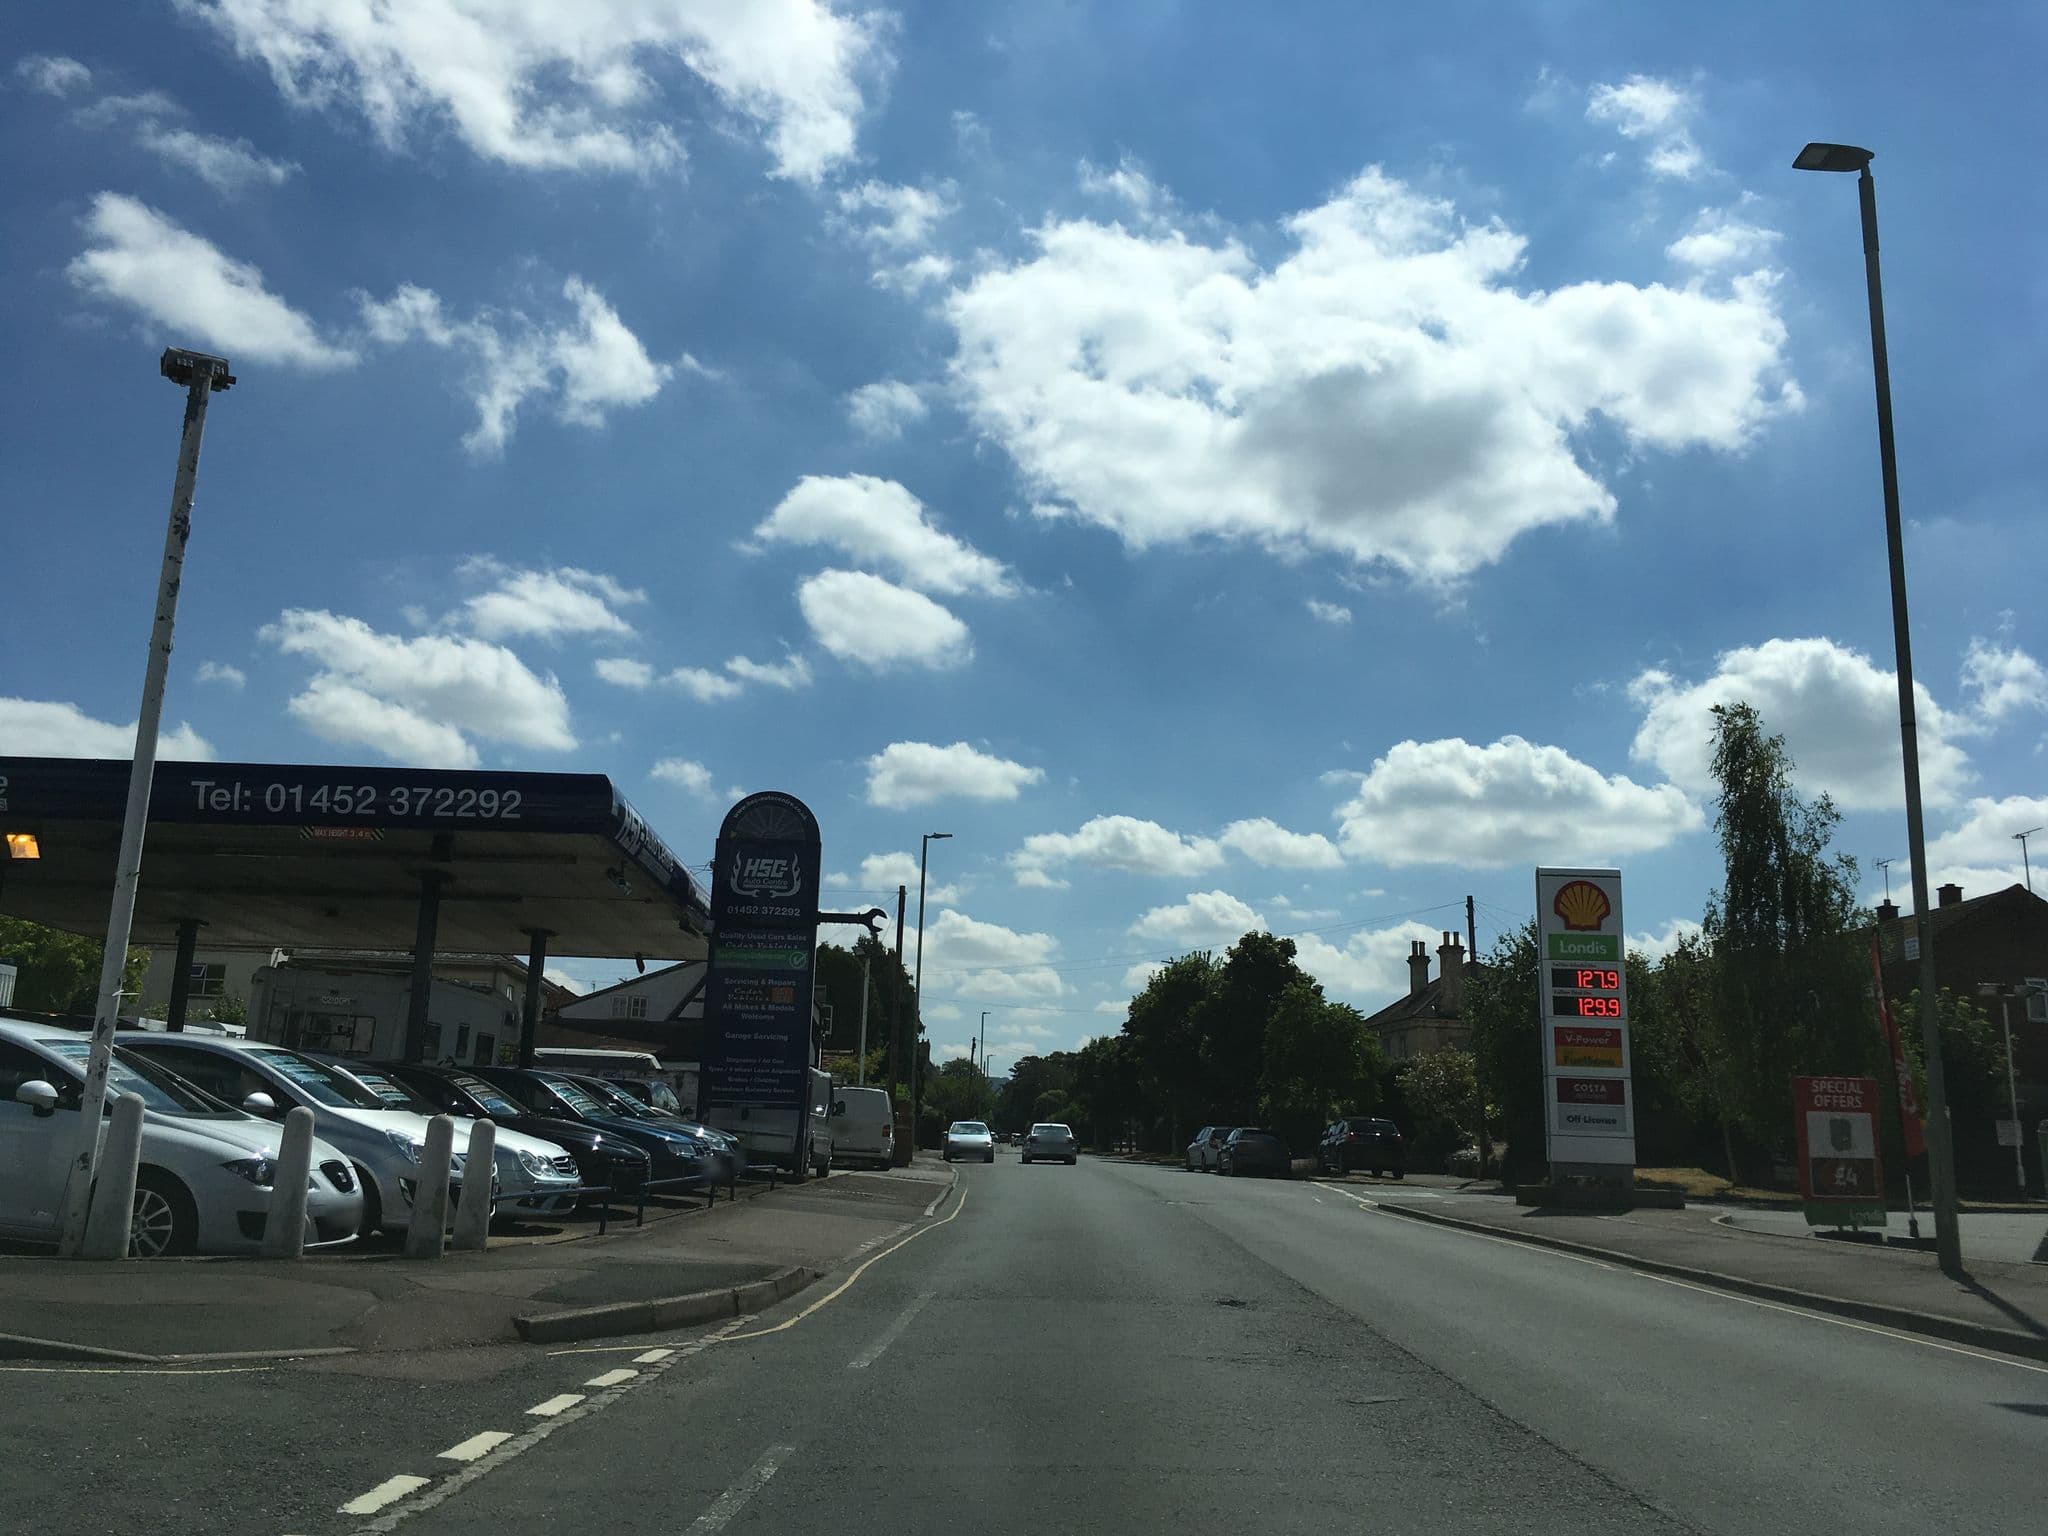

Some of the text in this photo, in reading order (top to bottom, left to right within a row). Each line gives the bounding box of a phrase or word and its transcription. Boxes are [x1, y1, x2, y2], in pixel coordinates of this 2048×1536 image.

[190, 780, 521, 820] Tel: 01452 372292
[328, 829, 349, 837] HEIGHT
[743, 858, 789, 878] HSC
[762, 878, 789, 886] Centre
[727, 905, 801, 917] 01452 372292
[720, 932, 746, 941] Quality
[1560, 940, 1607, 954] Londis
[724, 978, 759, 986] Servicing
[768, 978, 796, 987] Repairs
[1577, 970, 1618, 989] 127.9
[734, 1003, 759, 1011] Makes
[768, 1004, 796, 1012] Models
[1578, 998, 1620, 1017] 129.9
[725, 1032, 789, 1042] Garage Servicing
[1565, 1034, 1610, 1045] V-Power
[1573, 1083, 1608, 1092] COSTA
[1811, 1080, 1865, 1094] SPECIAL
[1814, 1095, 1863, 1108] OFFERS
[1834, 1167, 1859, 1187] £4
